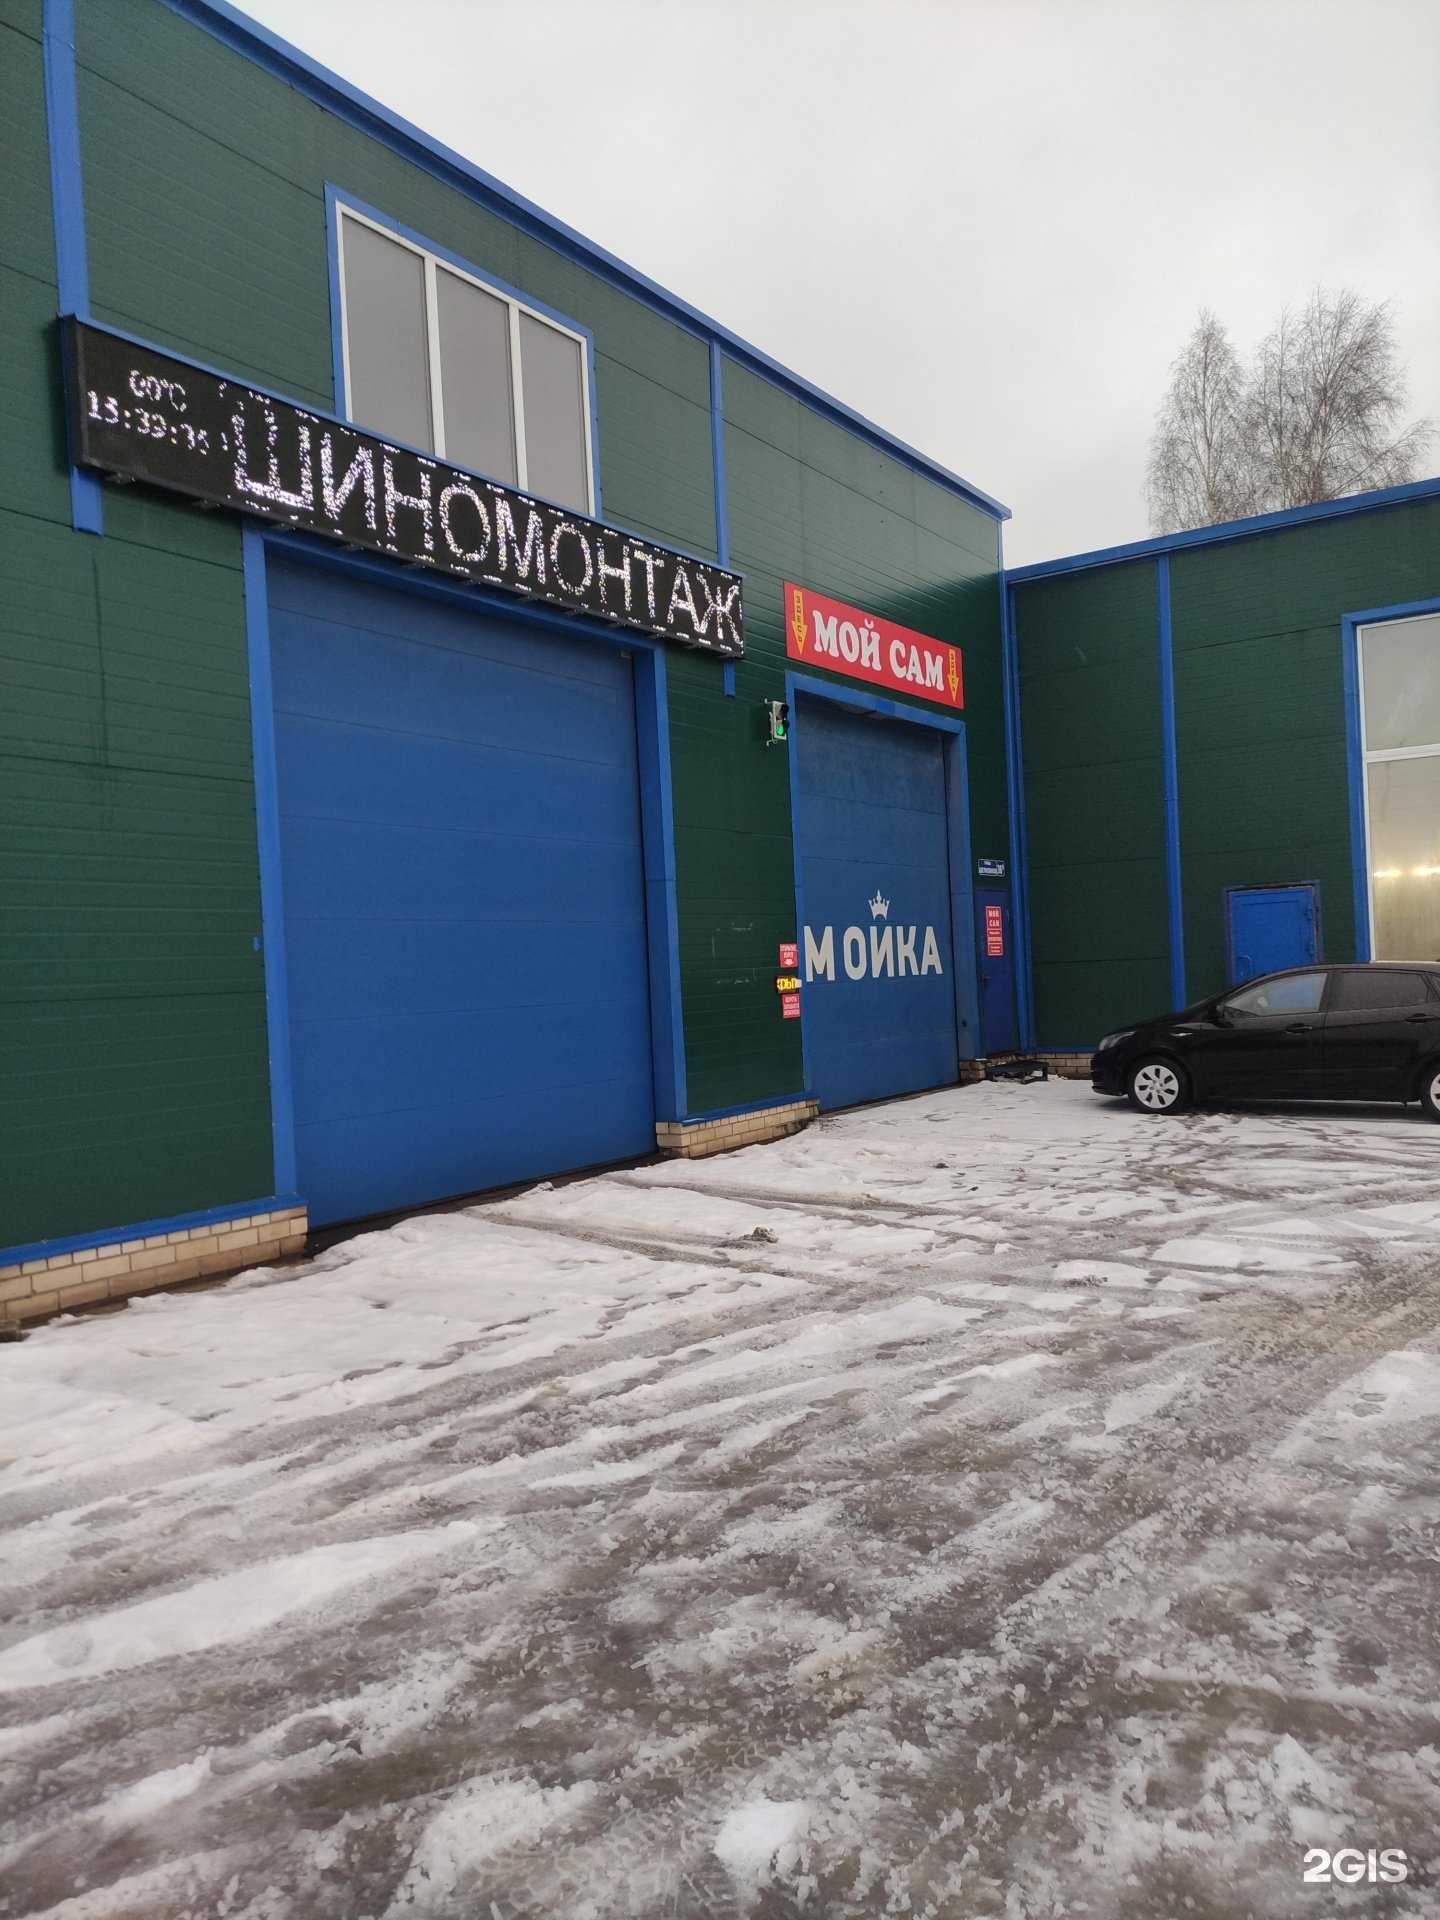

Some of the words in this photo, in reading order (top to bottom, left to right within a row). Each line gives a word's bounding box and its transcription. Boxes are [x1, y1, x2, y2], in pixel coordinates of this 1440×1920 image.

[232, 408, 743, 646] ШИНОМОНТАЖ
[812, 609, 882, 672] МОЙ
[889, 638, 945, 692] САМ
